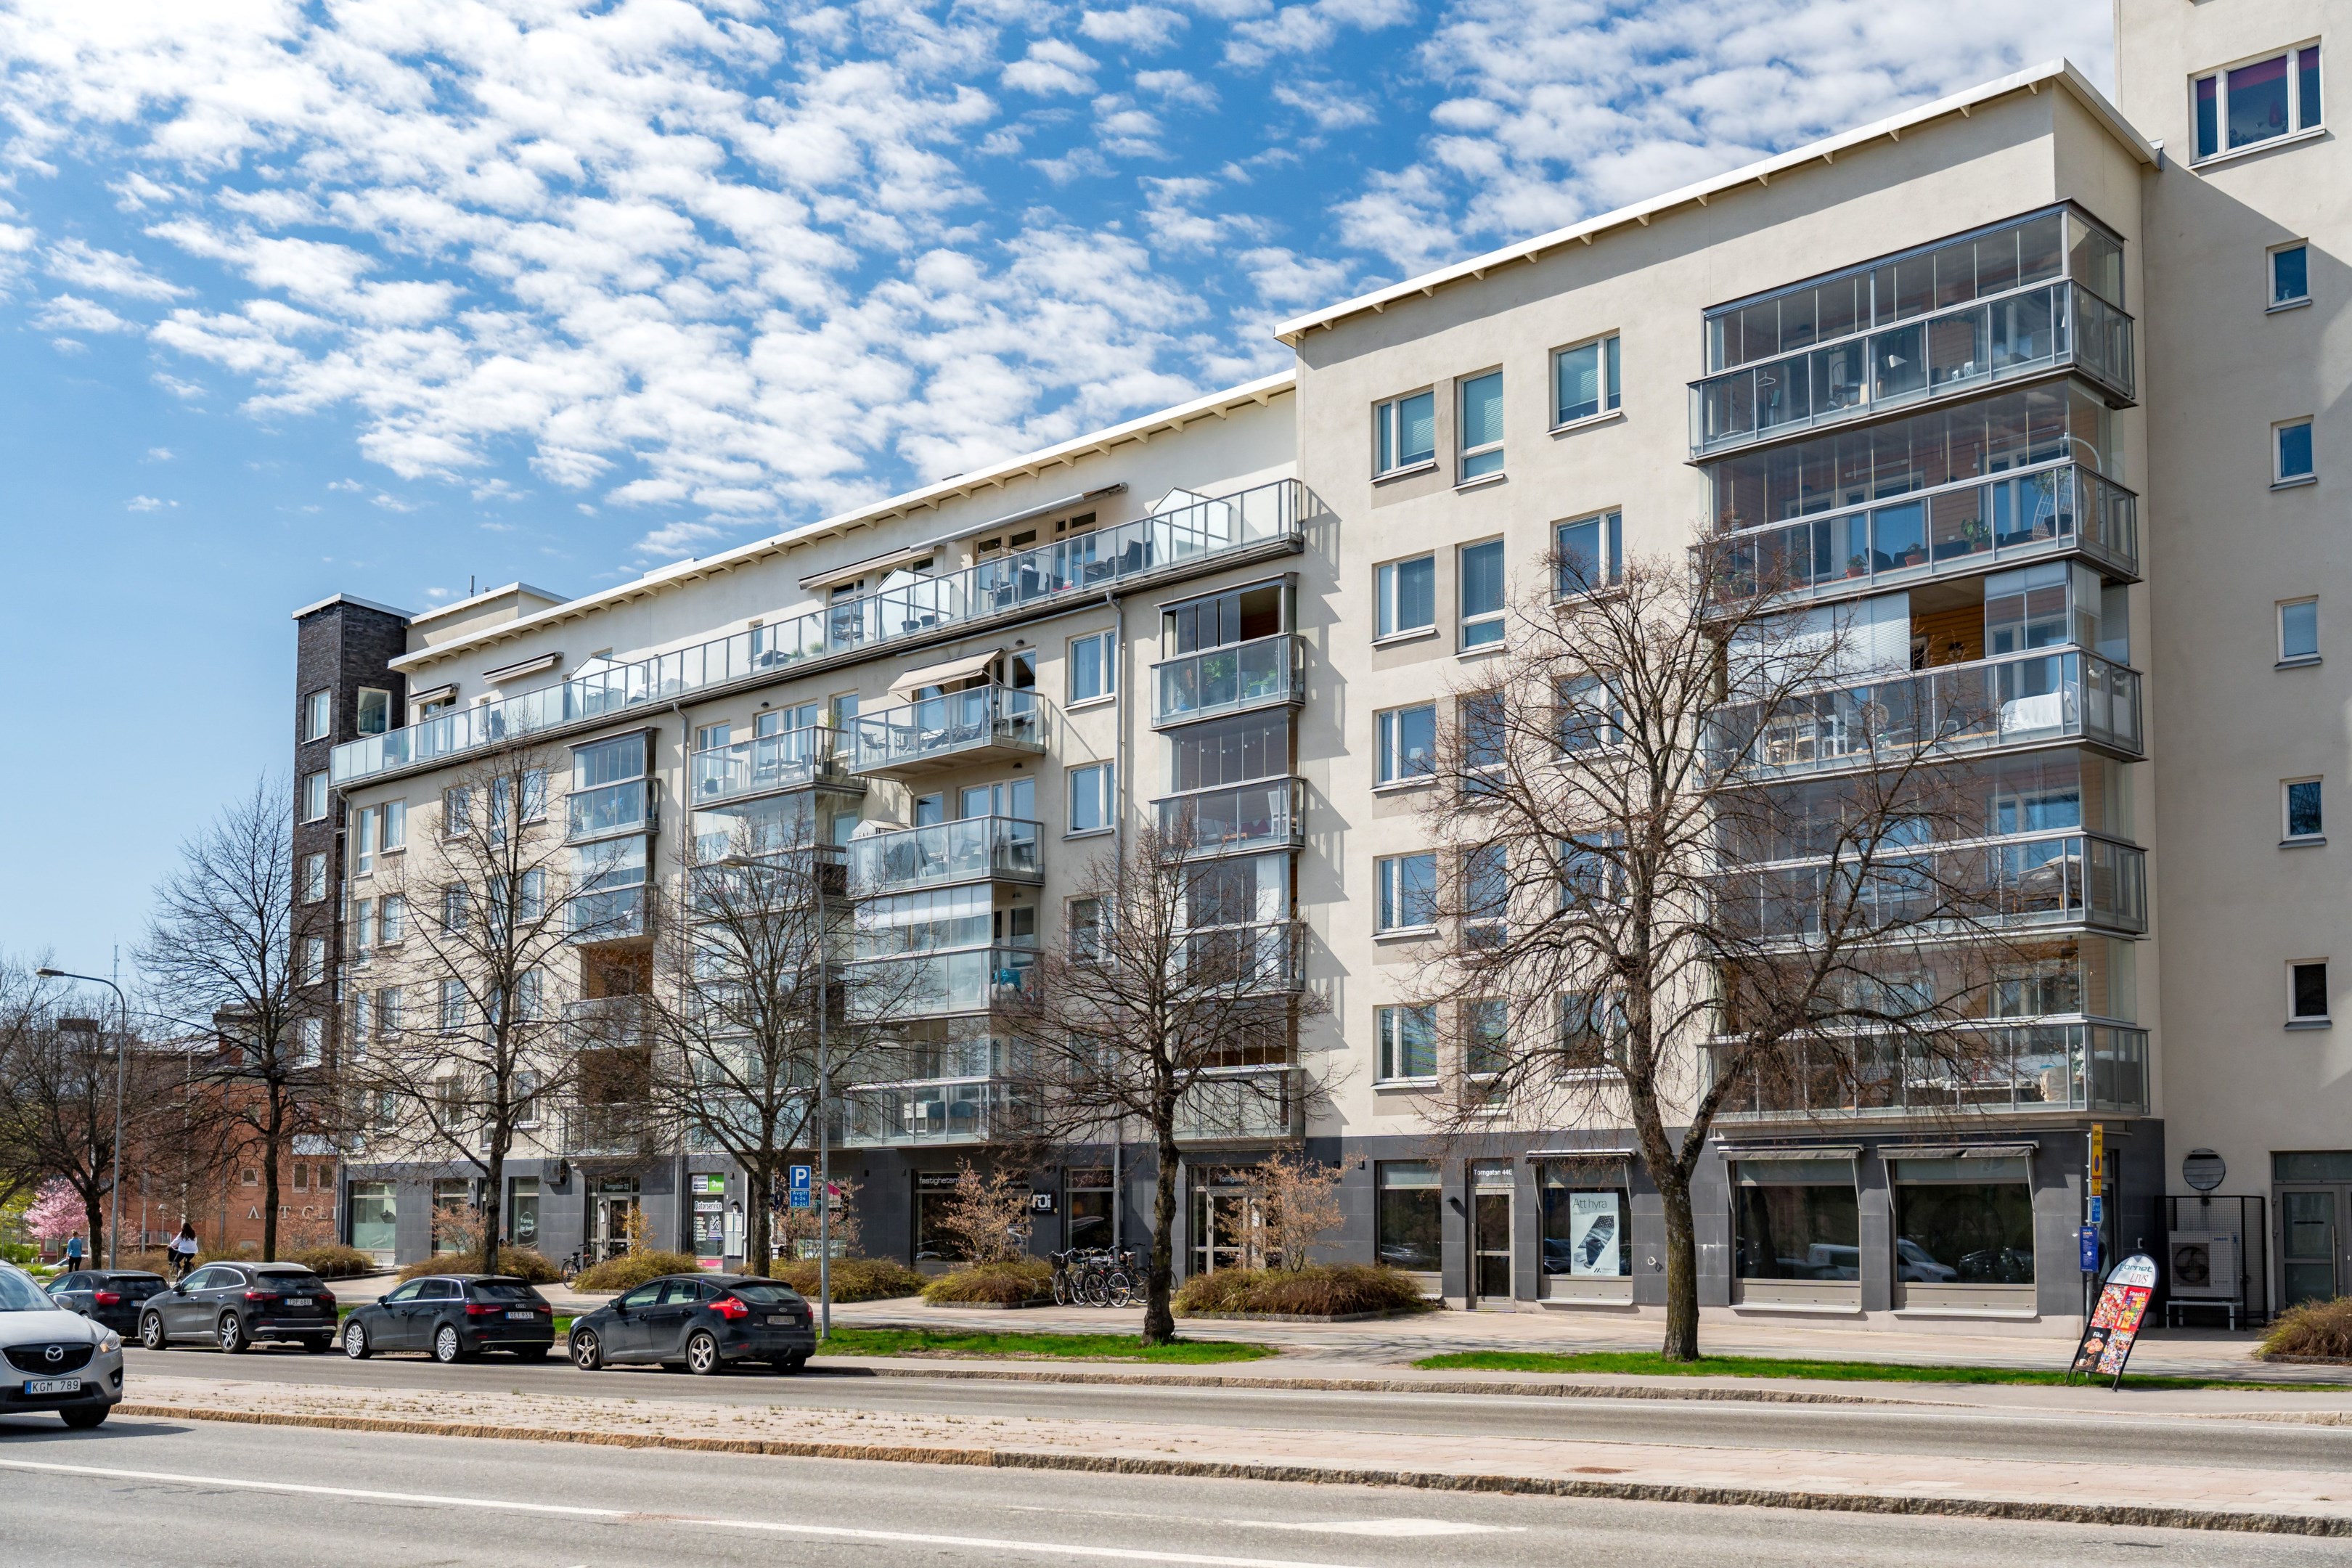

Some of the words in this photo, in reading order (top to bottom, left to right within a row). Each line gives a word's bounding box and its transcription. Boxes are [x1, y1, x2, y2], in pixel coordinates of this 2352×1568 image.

[795, 1168, 807, 1187] P
[695, 1200, 722, 1210] Datorservice
[1572, 1198, 1587, 1209] Att
[1588, 1198, 1607, 1211] hyra
[247, 1205, 291, 1220] AT
[2119, 1263, 2154, 1273] tornet
[2129, 1273, 2149, 1284] LIVS
[33, 1382, 53, 1392] KGM
[60, 1380, 78, 1390] 789
